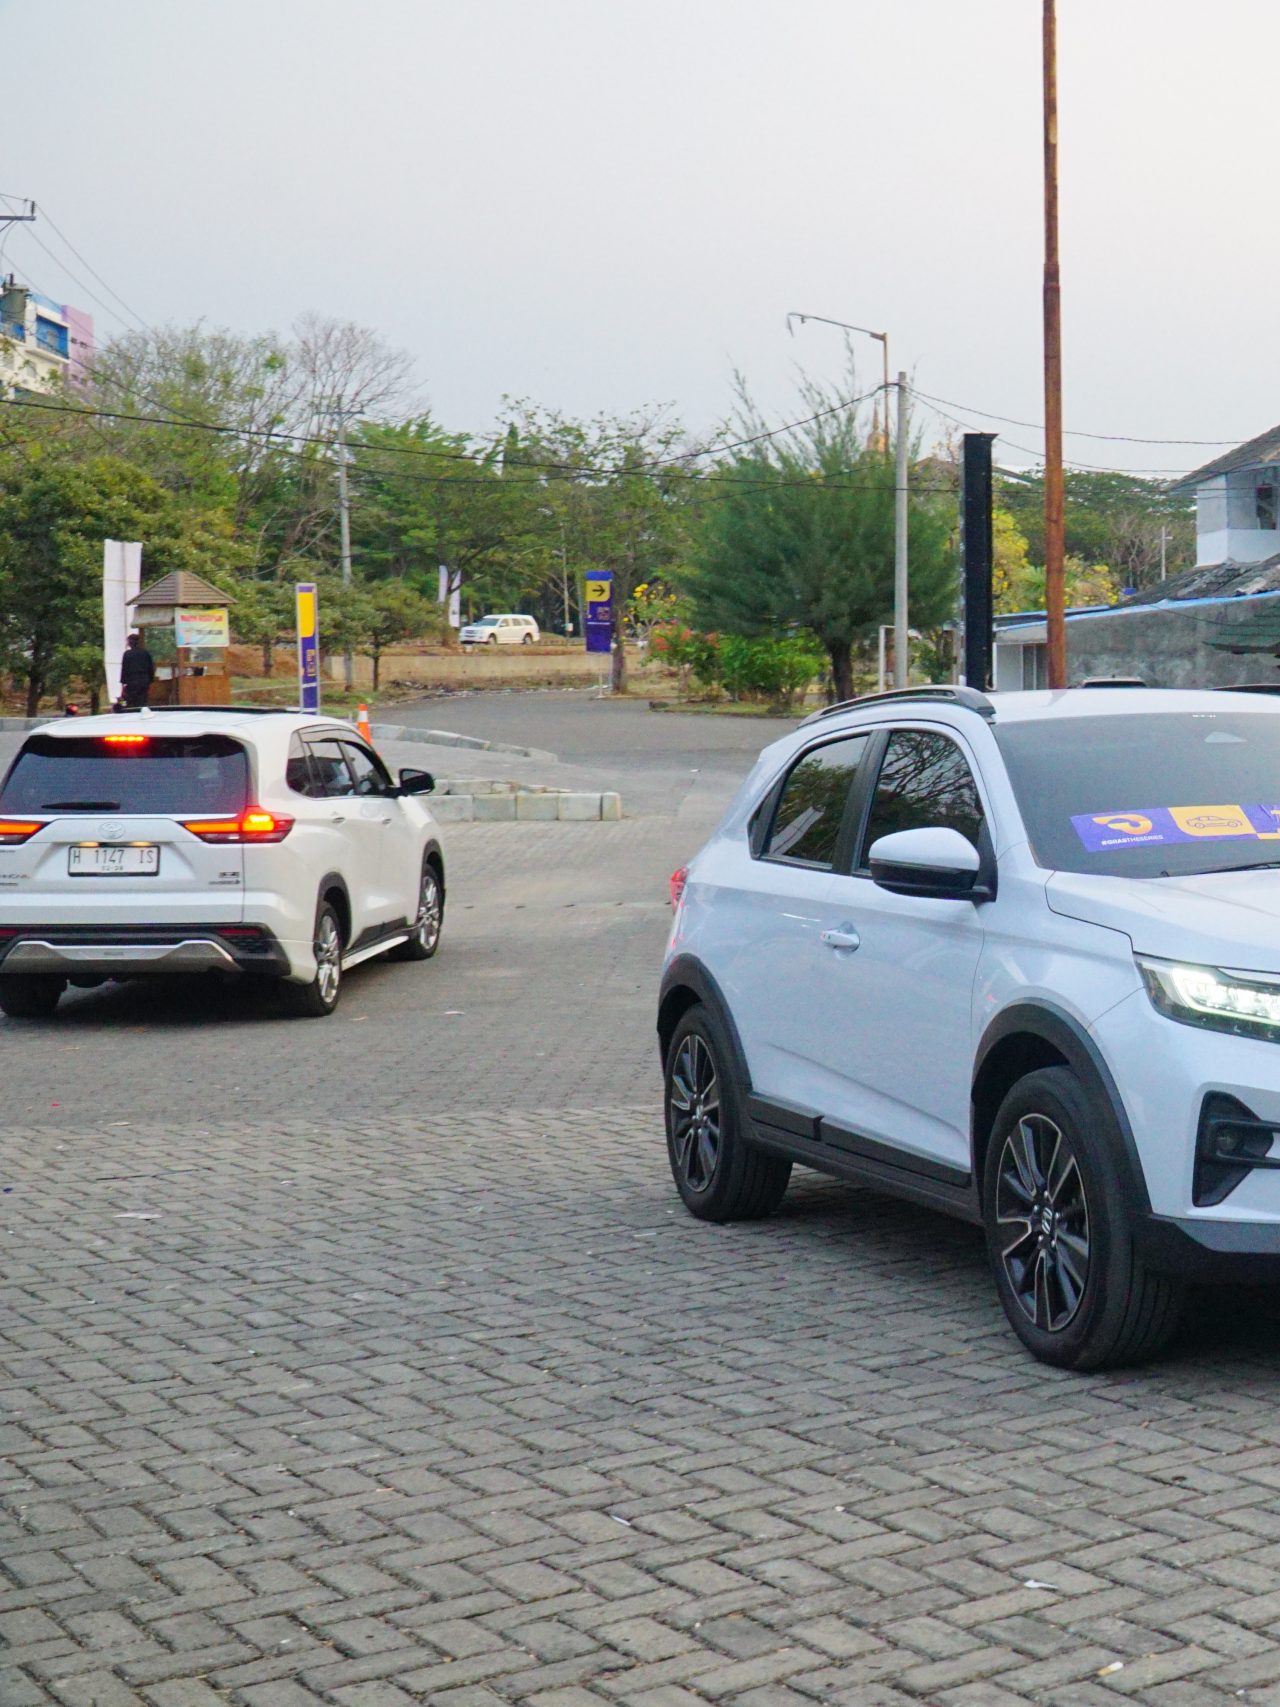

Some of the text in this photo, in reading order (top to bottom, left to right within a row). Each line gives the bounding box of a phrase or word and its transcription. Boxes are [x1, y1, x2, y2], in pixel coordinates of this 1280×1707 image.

[73, 849, 154, 864] H 1147 IS
